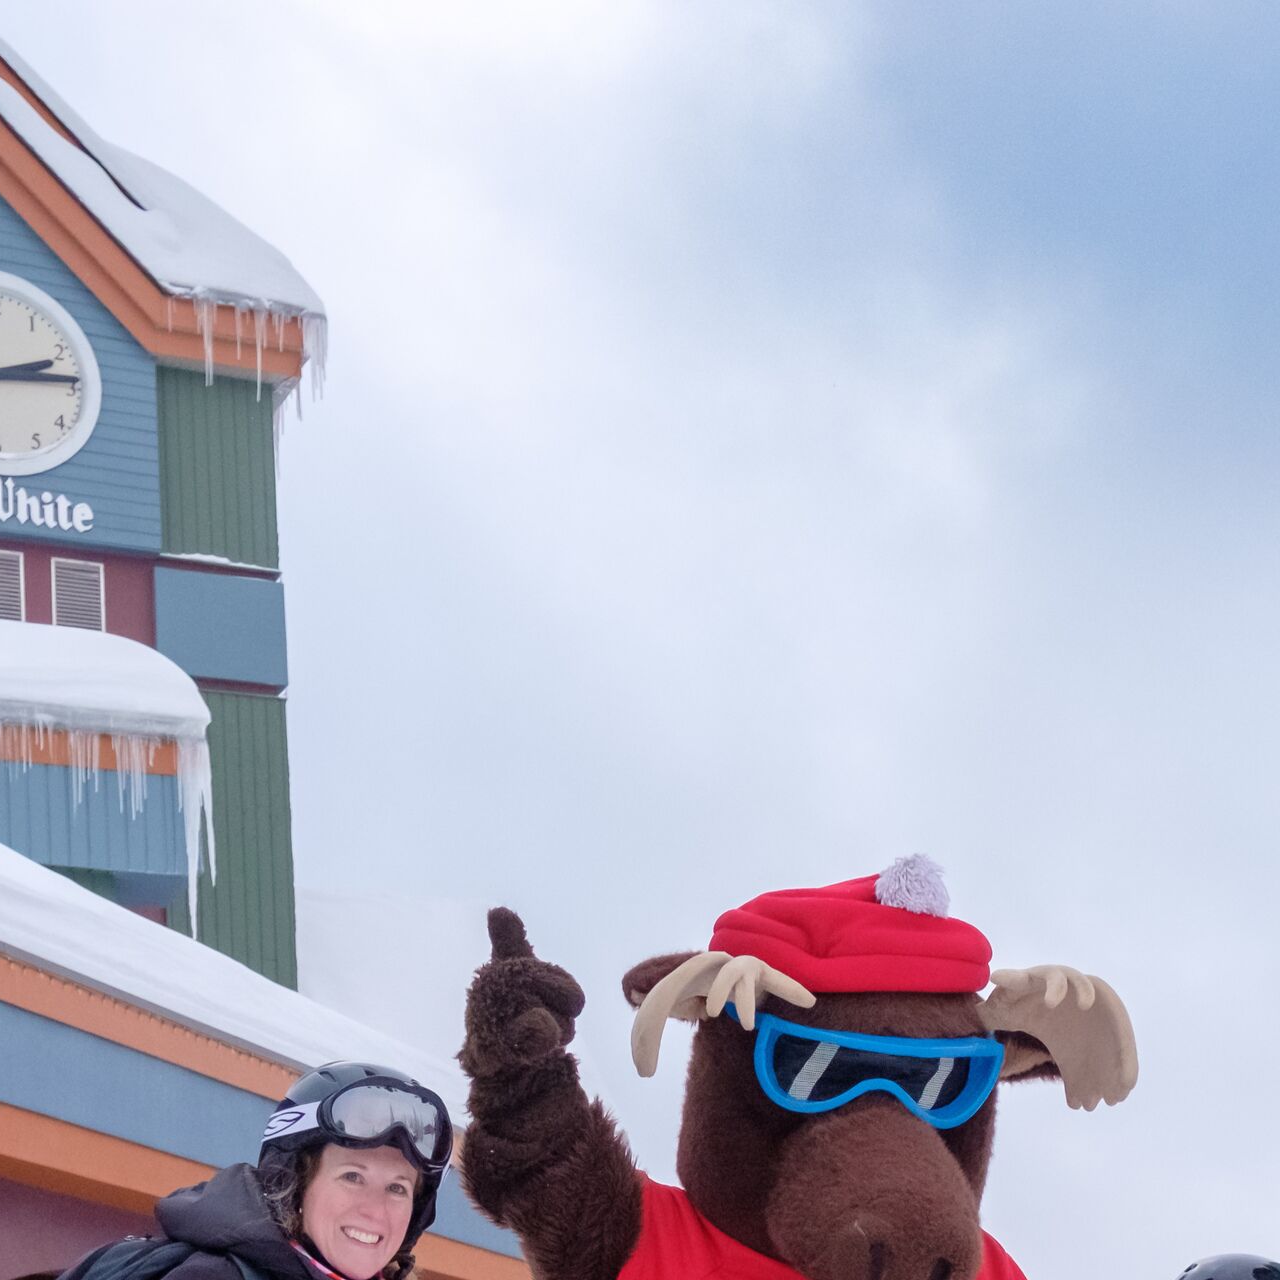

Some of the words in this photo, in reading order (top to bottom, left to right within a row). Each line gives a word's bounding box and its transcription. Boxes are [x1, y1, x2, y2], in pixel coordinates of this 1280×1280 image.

[28, 315, 36, 332] 1
[54, 343, 65, 361] 2
[53, 413, 66, 431] 4
[30, 433, 42, 450] 5
